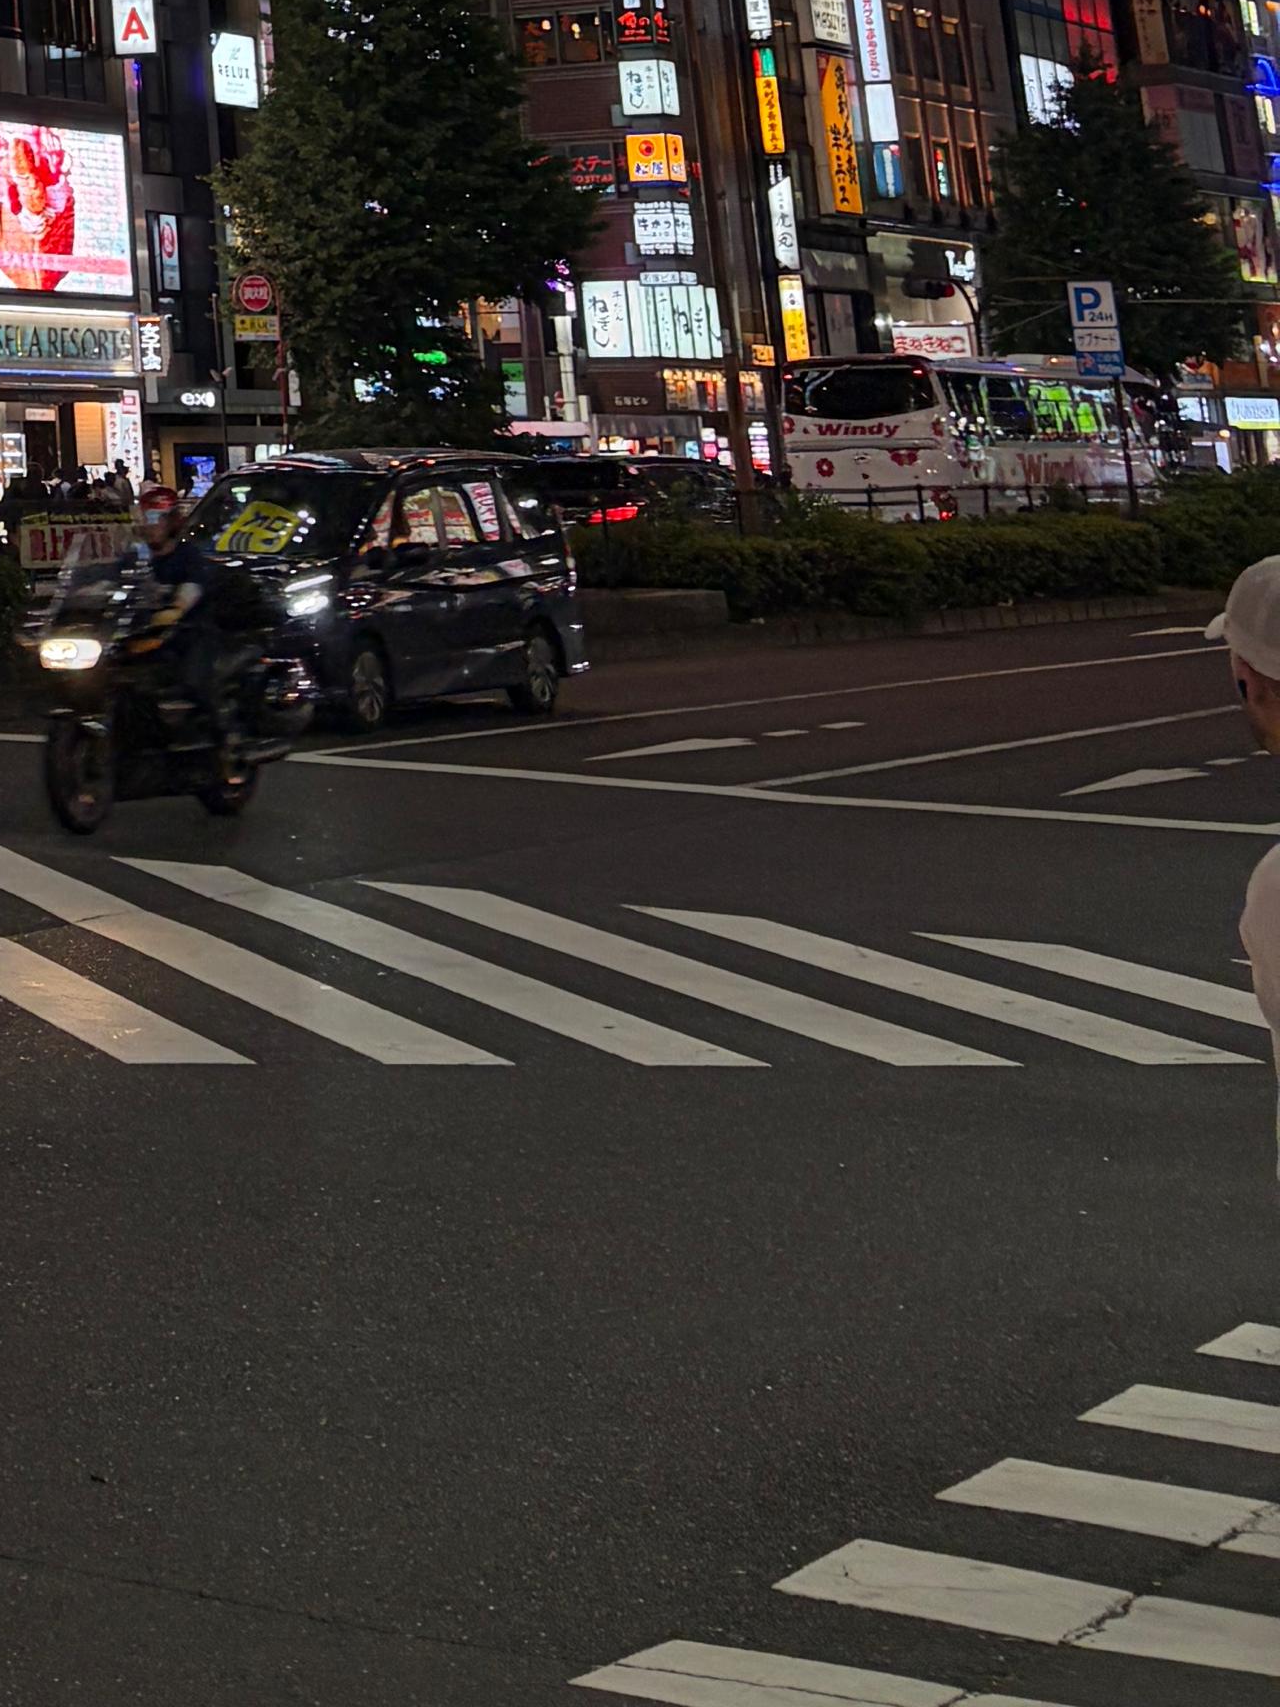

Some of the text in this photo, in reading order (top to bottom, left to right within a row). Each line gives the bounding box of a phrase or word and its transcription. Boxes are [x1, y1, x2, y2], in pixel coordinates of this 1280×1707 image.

[1074, 287, 1114, 323] P 24H
[43, 320, 133, 360] RESORTS
[894, 334, 967, 355] まねきねこ
[817, 421, 901, 440] Windy
